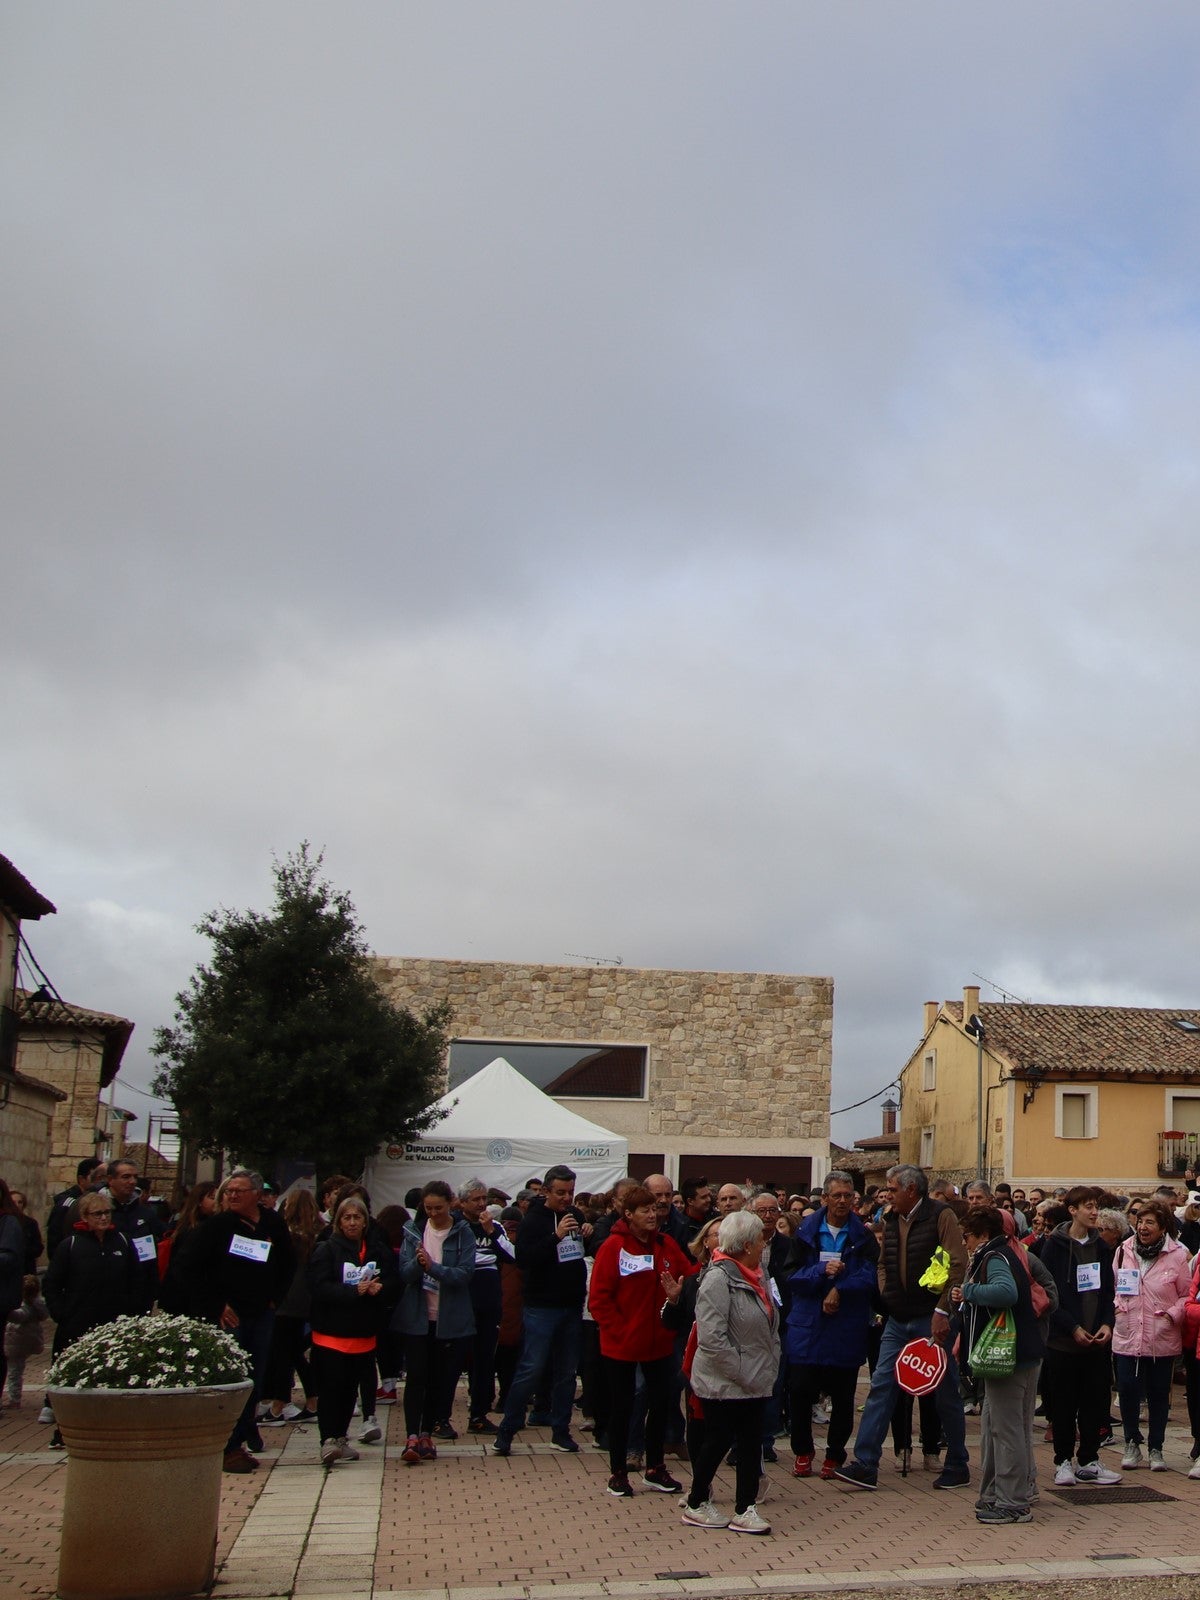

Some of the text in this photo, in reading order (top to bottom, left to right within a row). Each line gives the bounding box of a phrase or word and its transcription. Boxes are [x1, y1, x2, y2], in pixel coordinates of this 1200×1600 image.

[569, 1148, 610, 1156] AVANZA
[986, 1345, 1012, 1355] aecc
[901, 1353, 936, 1378] STOP
